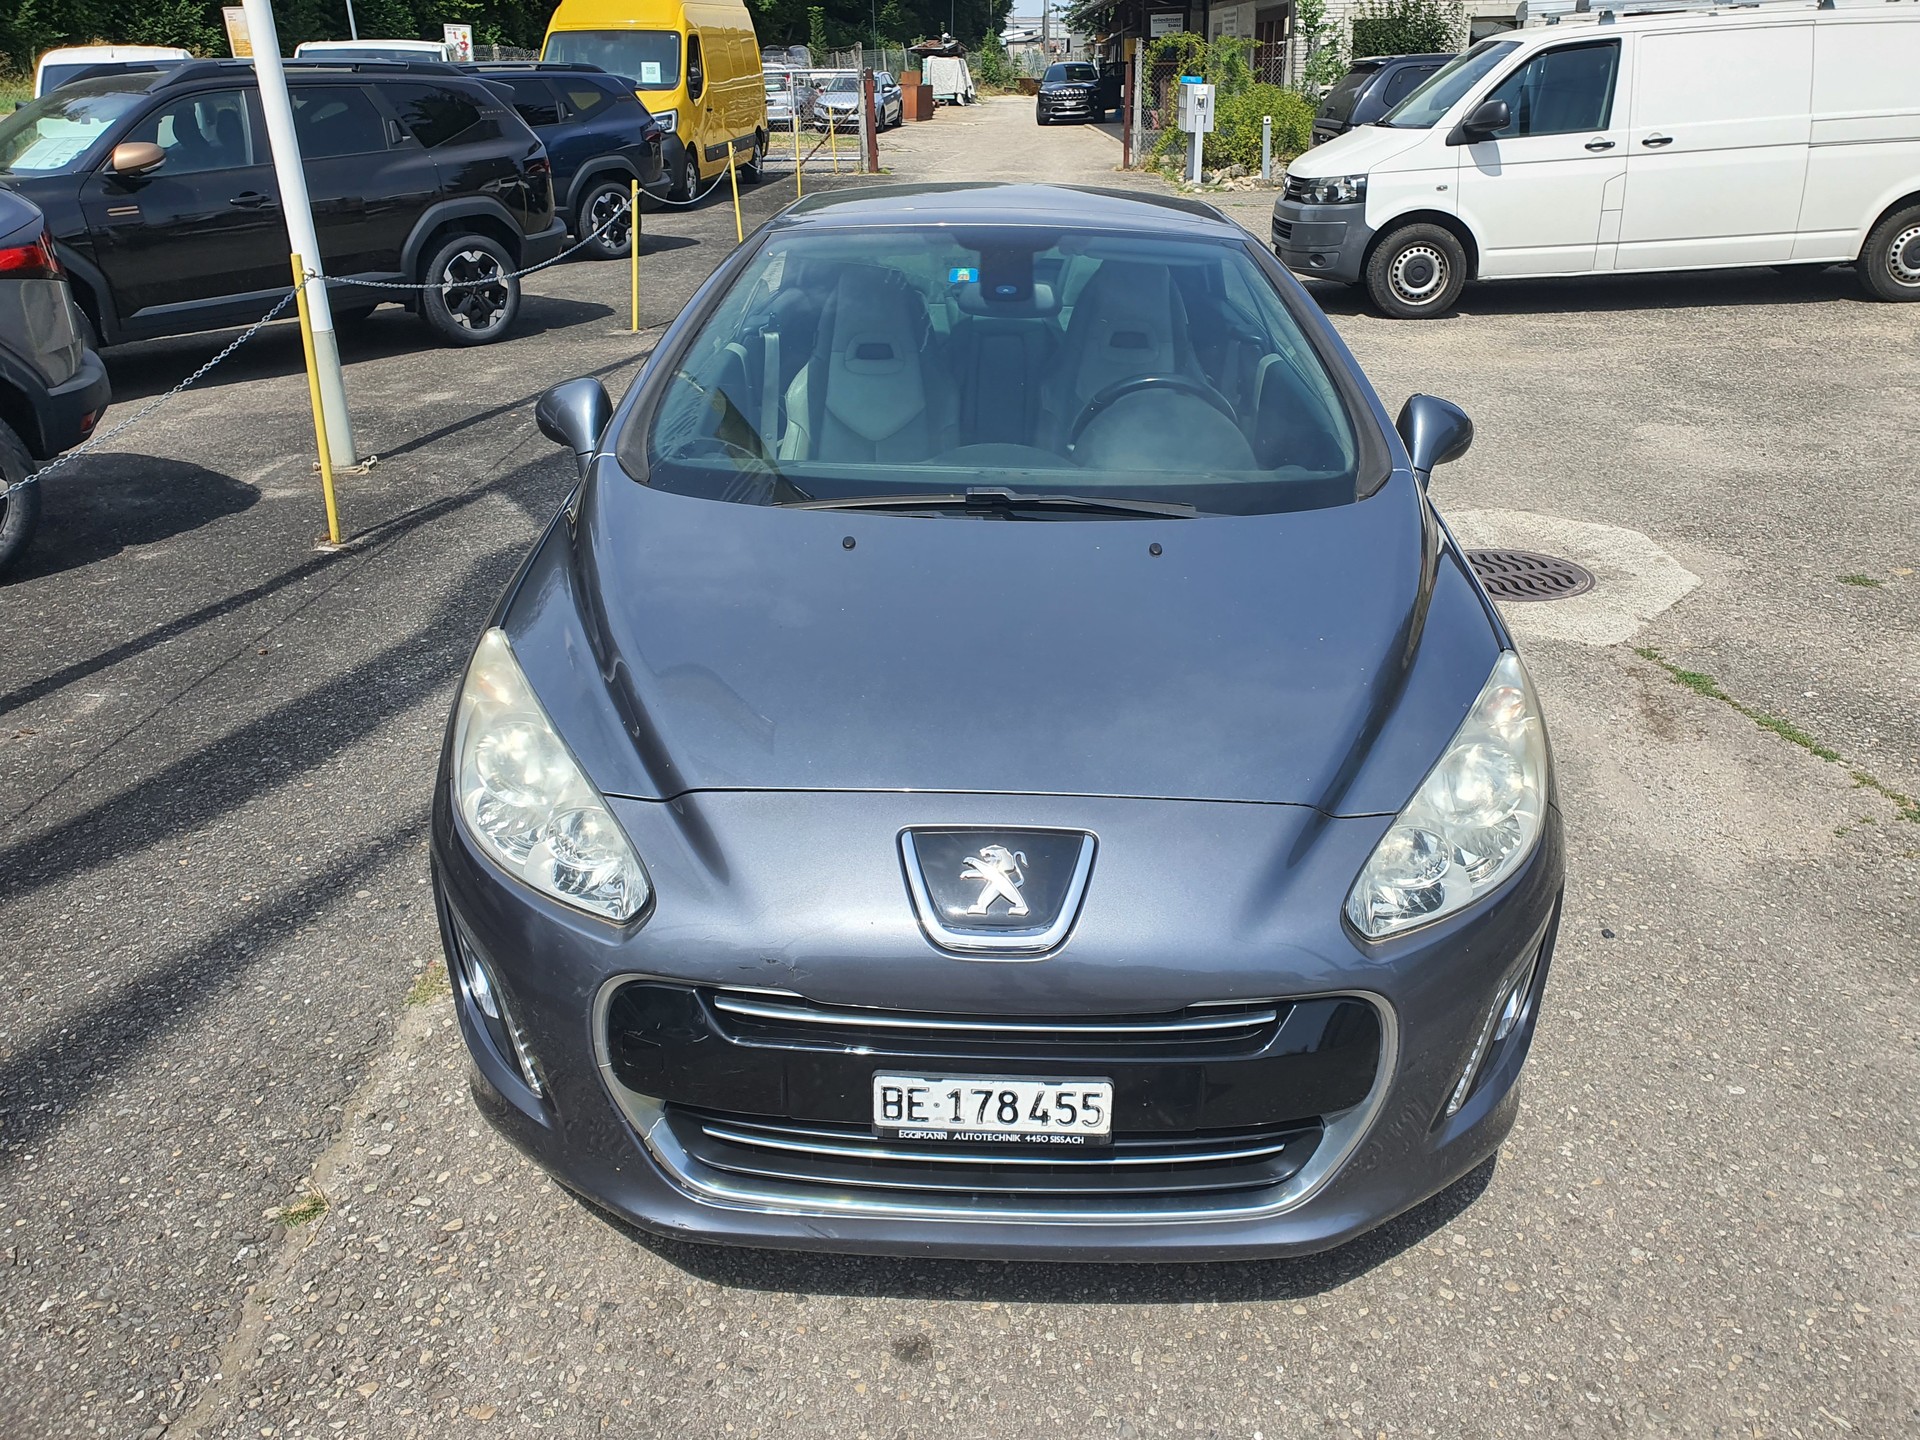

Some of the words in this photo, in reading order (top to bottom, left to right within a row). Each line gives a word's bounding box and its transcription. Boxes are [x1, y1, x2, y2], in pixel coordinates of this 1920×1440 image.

[899, 1130, 948, 1140] EGGIMANN
[953, 1132, 1021, 1142] AUTOTECHNIK
[1025, 1134, 1048, 1143] 4450
[1050, 1135, 1085, 1145] SISSACH
